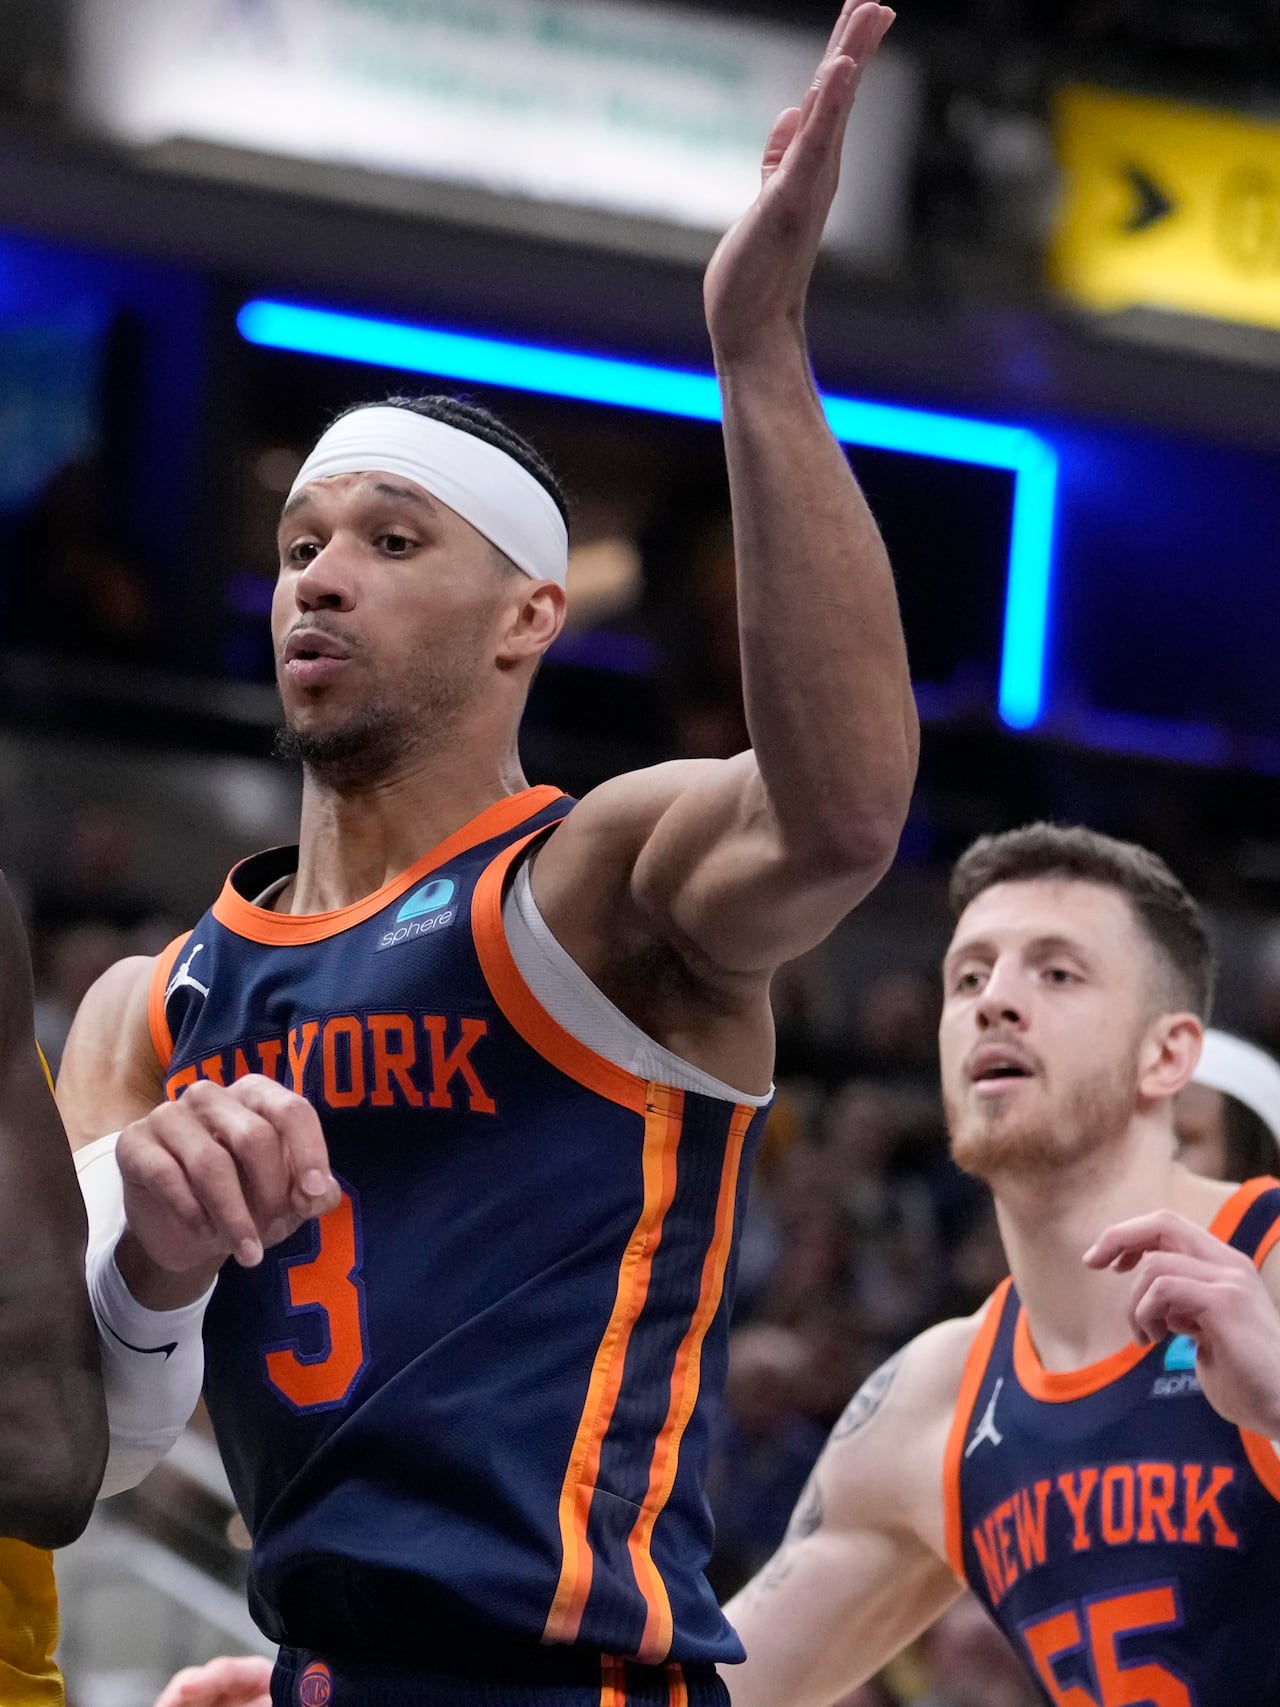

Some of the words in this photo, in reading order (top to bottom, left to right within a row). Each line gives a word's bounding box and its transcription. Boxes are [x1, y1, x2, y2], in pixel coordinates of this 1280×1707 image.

[381, 911, 453, 946] sphere
[288, 1013, 497, 1115] YORK
[264, 1182, 369, 1410] 3
[973, 1479, 1051, 1606] NEW
[1058, 1463, 1238, 1551] YORK
